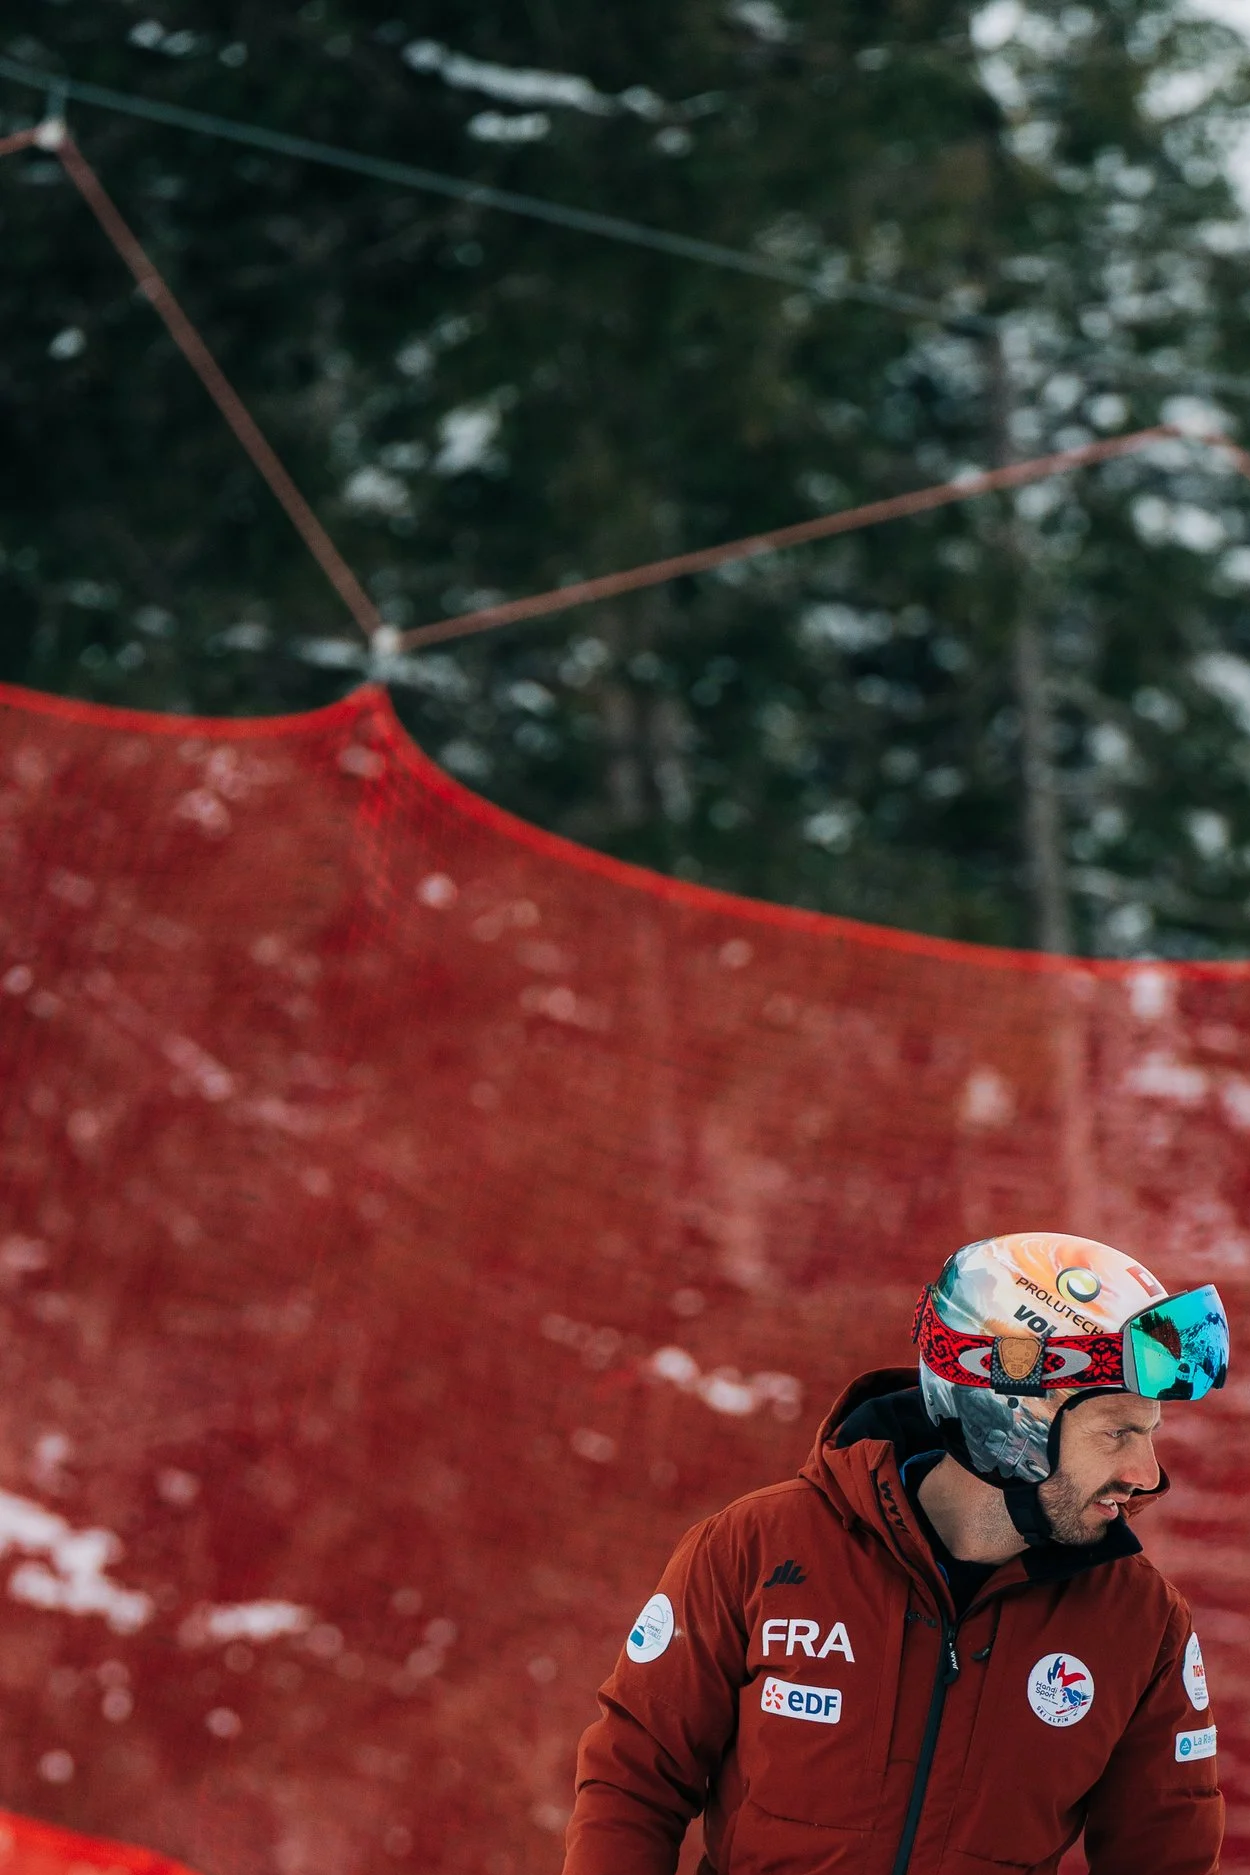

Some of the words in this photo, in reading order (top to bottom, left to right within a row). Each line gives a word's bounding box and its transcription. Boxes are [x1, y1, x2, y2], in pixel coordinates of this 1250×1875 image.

[1016, 1276, 1106, 1336] PROLUTECH
[762, 1618, 856, 1663] FRA
[1035, 1686, 1056, 1700] Sport
